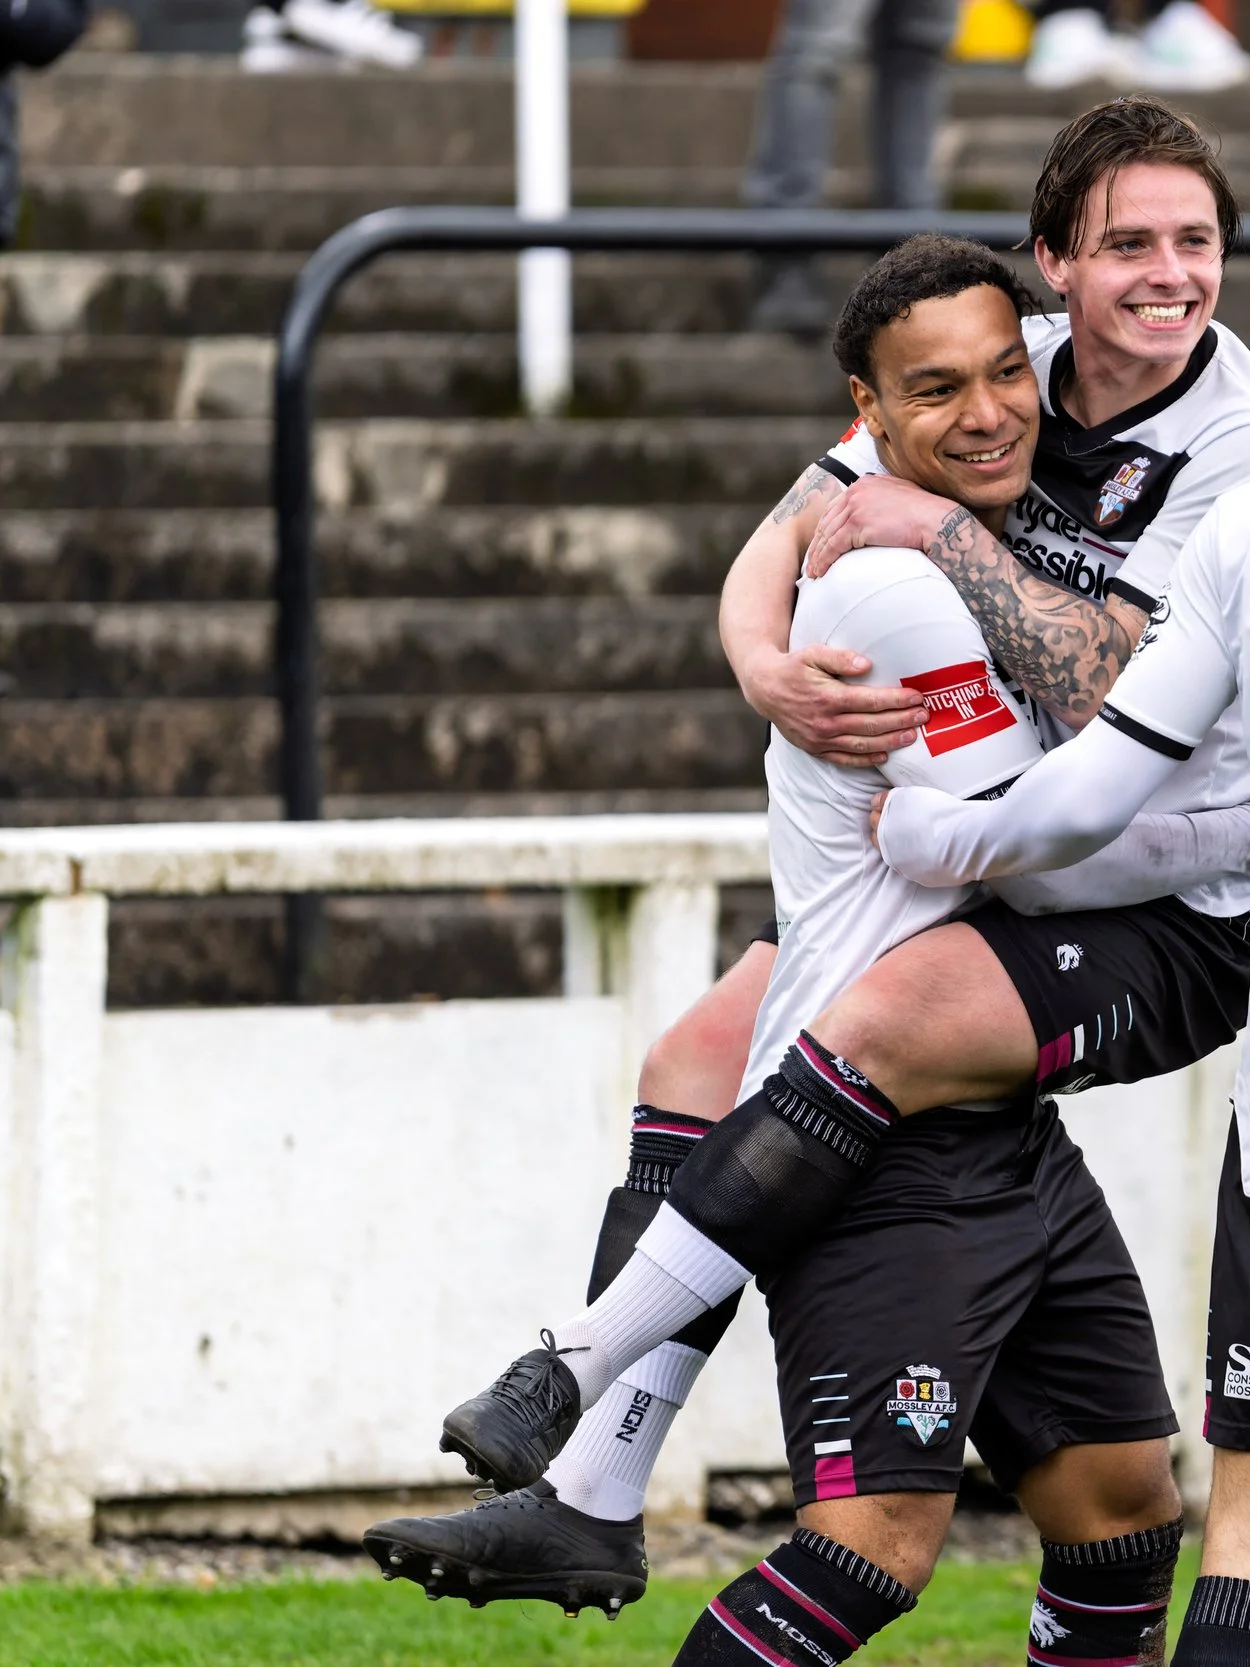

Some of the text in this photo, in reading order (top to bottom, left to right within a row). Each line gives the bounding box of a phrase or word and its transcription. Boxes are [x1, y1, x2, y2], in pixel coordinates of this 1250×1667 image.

[923, 683, 985, 712] PITCHING
[956, 701, 977, 720] IN
[985, 791, 1000, 801] THE
[888, 1401, 933, 1411] MOSSLEY
